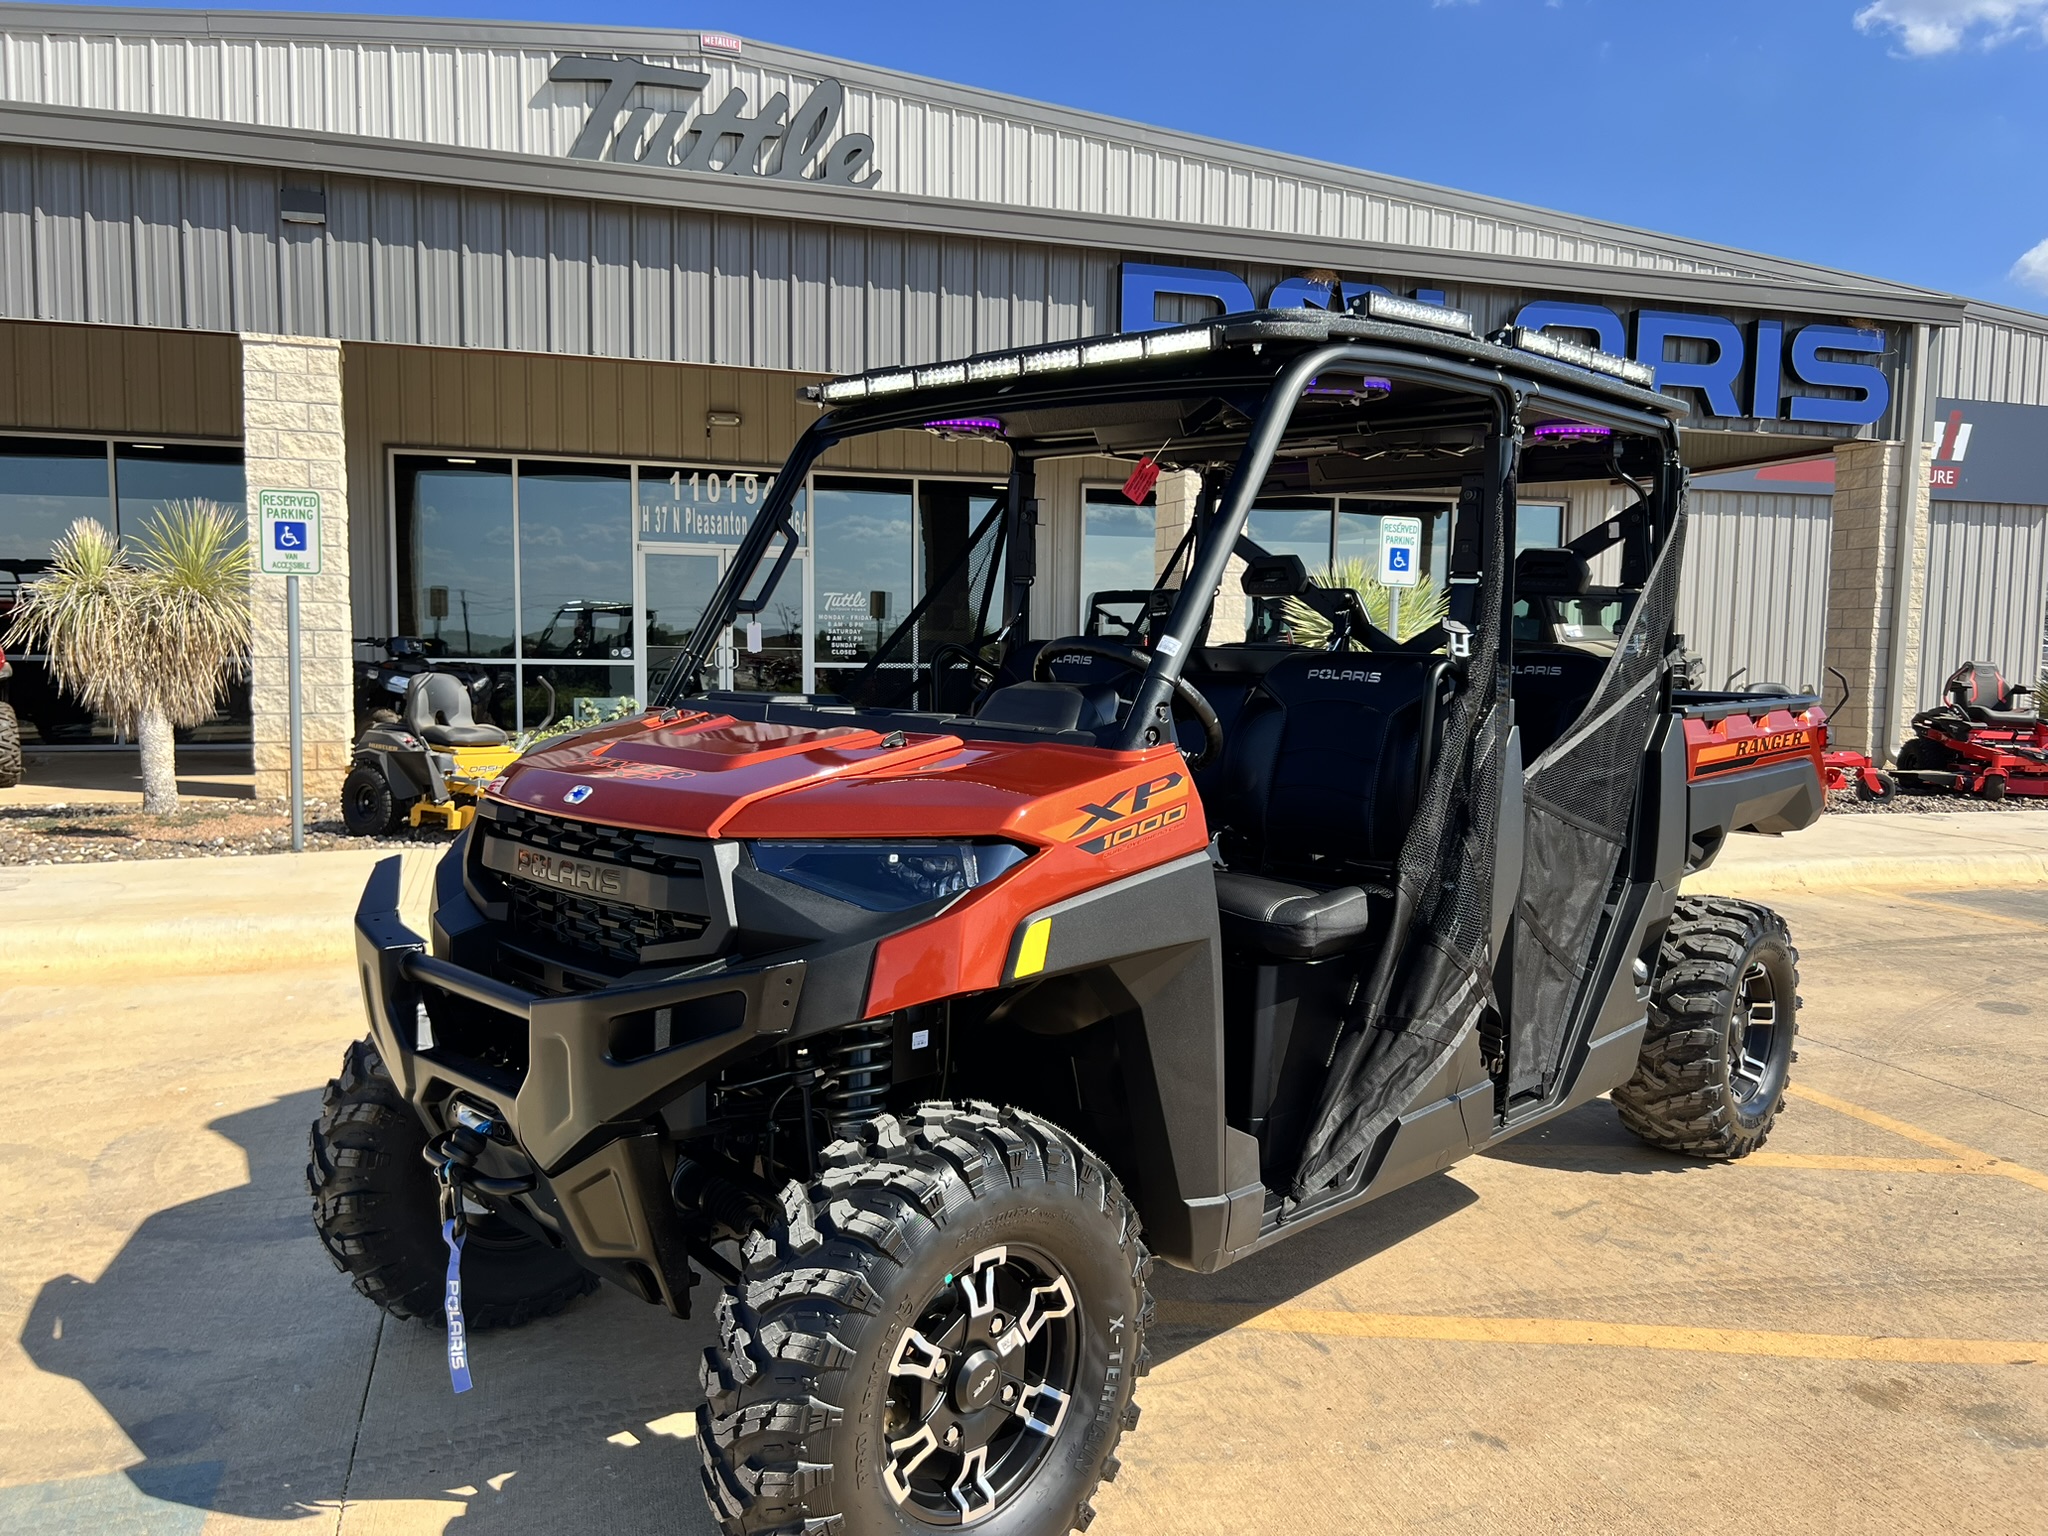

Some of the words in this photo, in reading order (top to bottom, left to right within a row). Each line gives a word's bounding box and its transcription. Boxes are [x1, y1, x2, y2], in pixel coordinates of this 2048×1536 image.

[704, 35, 738, 49] METALLIC
[549, 56, 882, 189] Tuttle
[262, 494, 317, 508] RESERVED
[266, 508, 314, 520] PARKING
[654, 505, 668, 533] 37
[673, 506, 680, 534] N
[685, 506, 748, 536] Pleasanton
[1384, 523, 1418, 534] RESERVED
[1385, 535, 1415, 546] PARKING
[284, 552, 298, 560] VAN
[272, 561, 311, 570] ACCESSIBLE
[823, 591, 867, 611] Tuttle
[1307, 669, 1382, 684] POLARIS
[1735, 730, 1804, 757] RANGER
[469, 764, 505, 773] DASH
[1068, 771, 1184, 850] XP
[1102, 805, 1187, 851] 1000
[517, 846, 623, 897] POLARIS
[447, 1280, 465, 1370] POLARIS
[1073, 1313, 1125, 1478] X-TERRAIN
